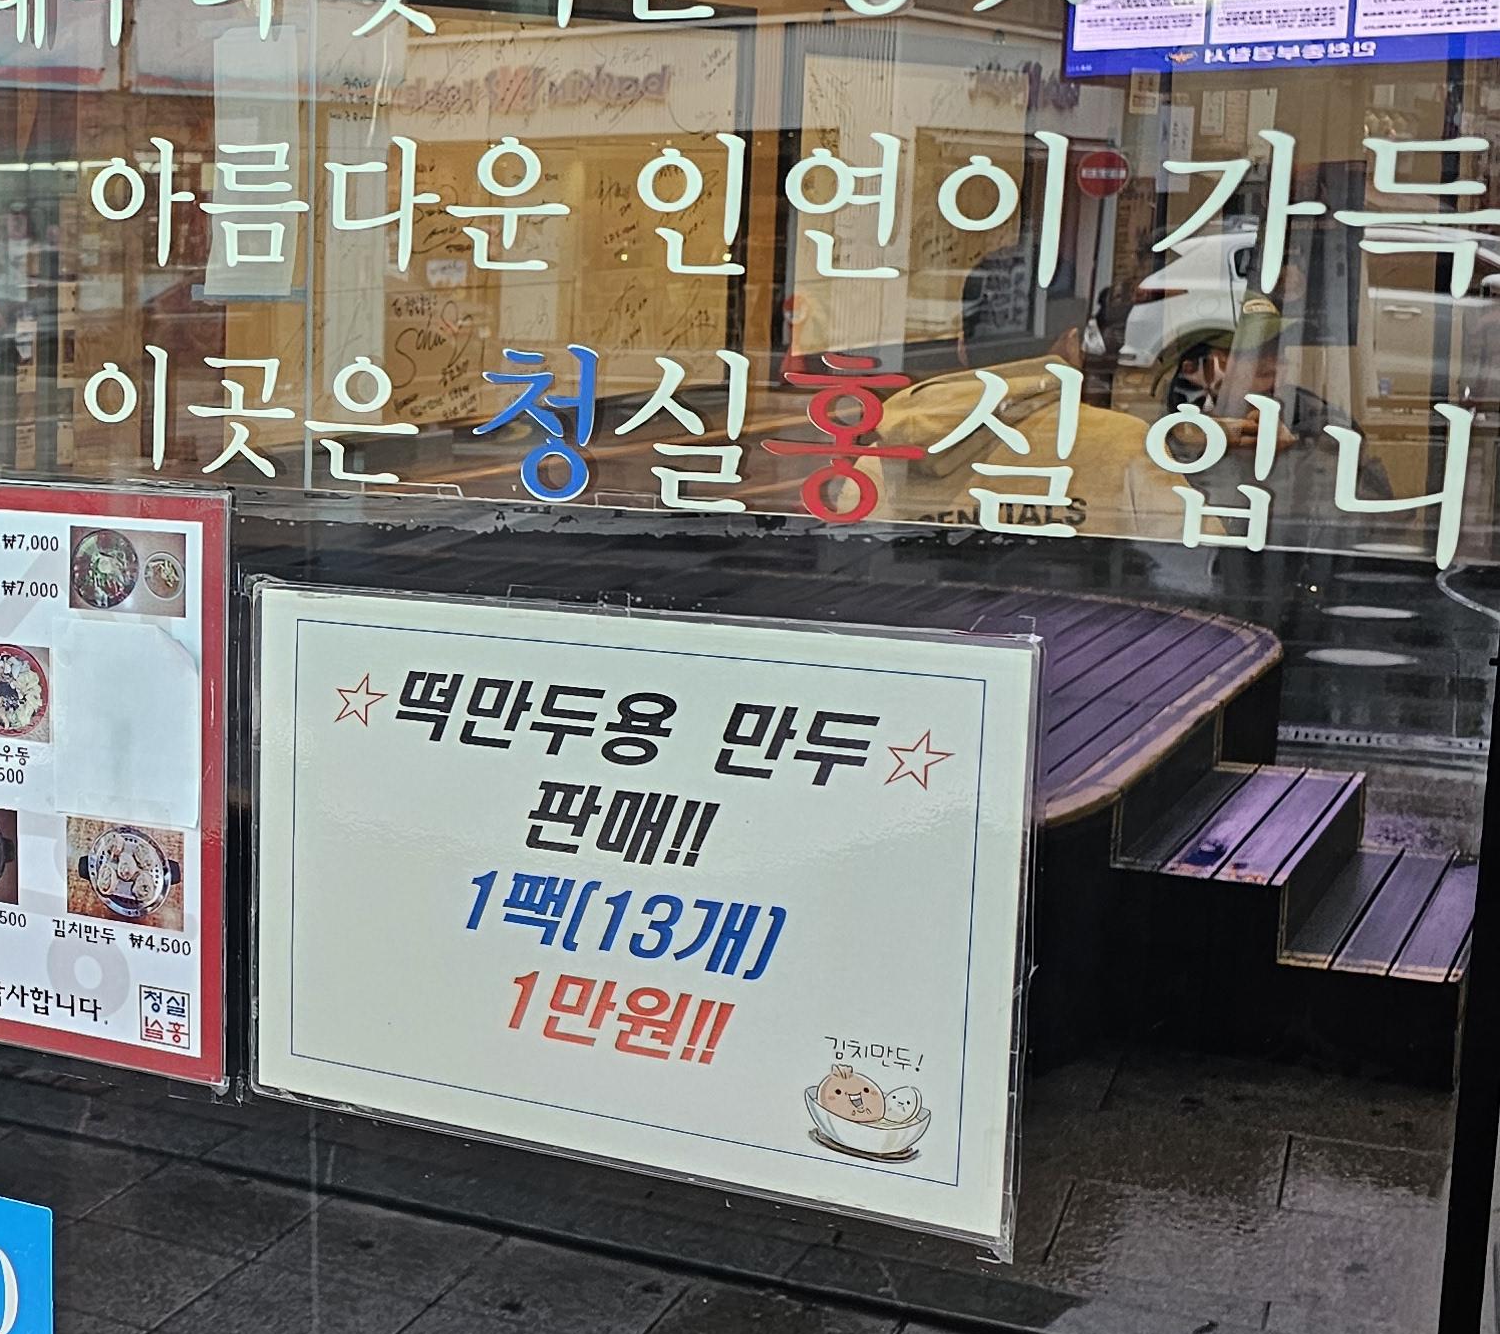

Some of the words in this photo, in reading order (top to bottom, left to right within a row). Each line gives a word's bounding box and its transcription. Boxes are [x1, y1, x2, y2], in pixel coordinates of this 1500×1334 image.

[91, 135, 569, 273] 아름다운
[636, 131, 1070, 290] 인연이
[1152, 129, 1500, 298] 가득
[83, 345, 419, 484] 이곳은
[1, 534, 60, 552] ₩7,000
[1, 579, 59, 599] ₩7,000
[393, 668, 680, 768] 떡만두용
[713, 702, 881, 788] 만두
[525, 779, 721, 869] 판매!!
[52, 919, 117, 945] 김치만두
[128, 932, 193, 957] ₩4,500
[463, 870, 788, 982] 1팩(13개)
[507, 970, 736, 1066] 1만원!!
[823, 1034, 925, 1074] 김치만두!
